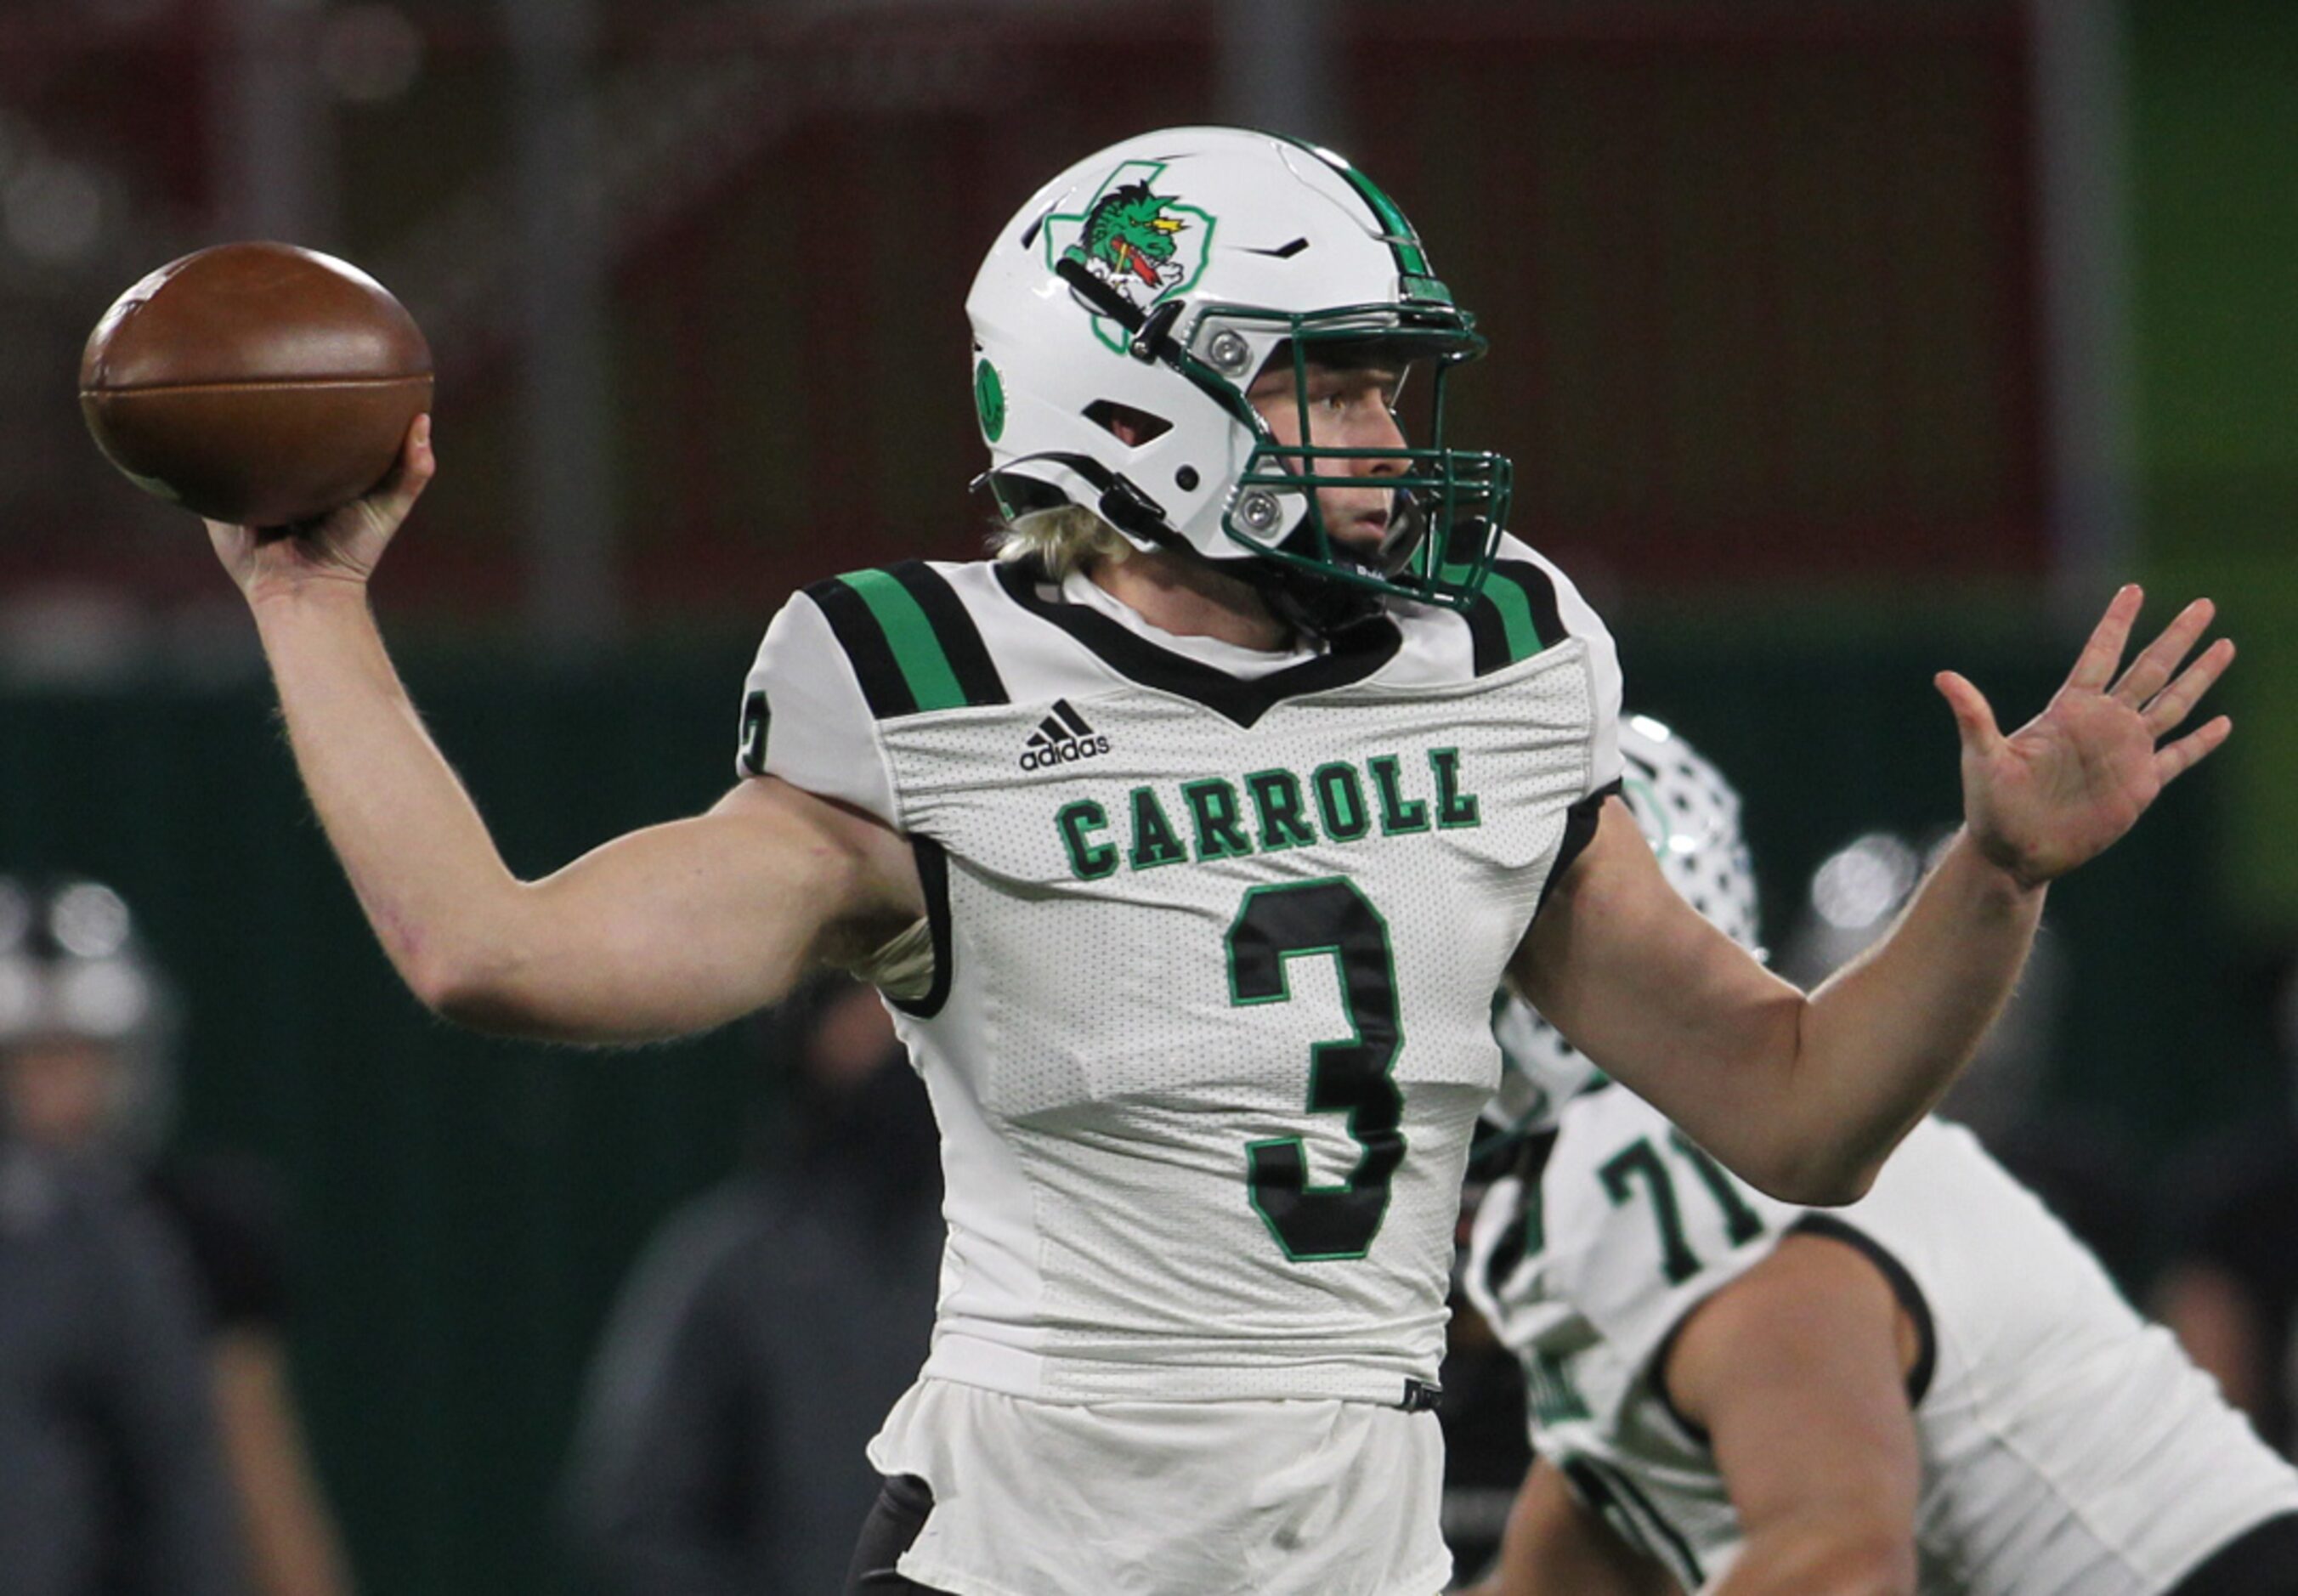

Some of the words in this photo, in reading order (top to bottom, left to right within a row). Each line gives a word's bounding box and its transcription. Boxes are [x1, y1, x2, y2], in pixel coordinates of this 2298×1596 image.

[1020, 736, 1110, 771] adidas
[1055, 746, 1481, 880] CARROLL
[1225, 874, 1407, 1263] 3
